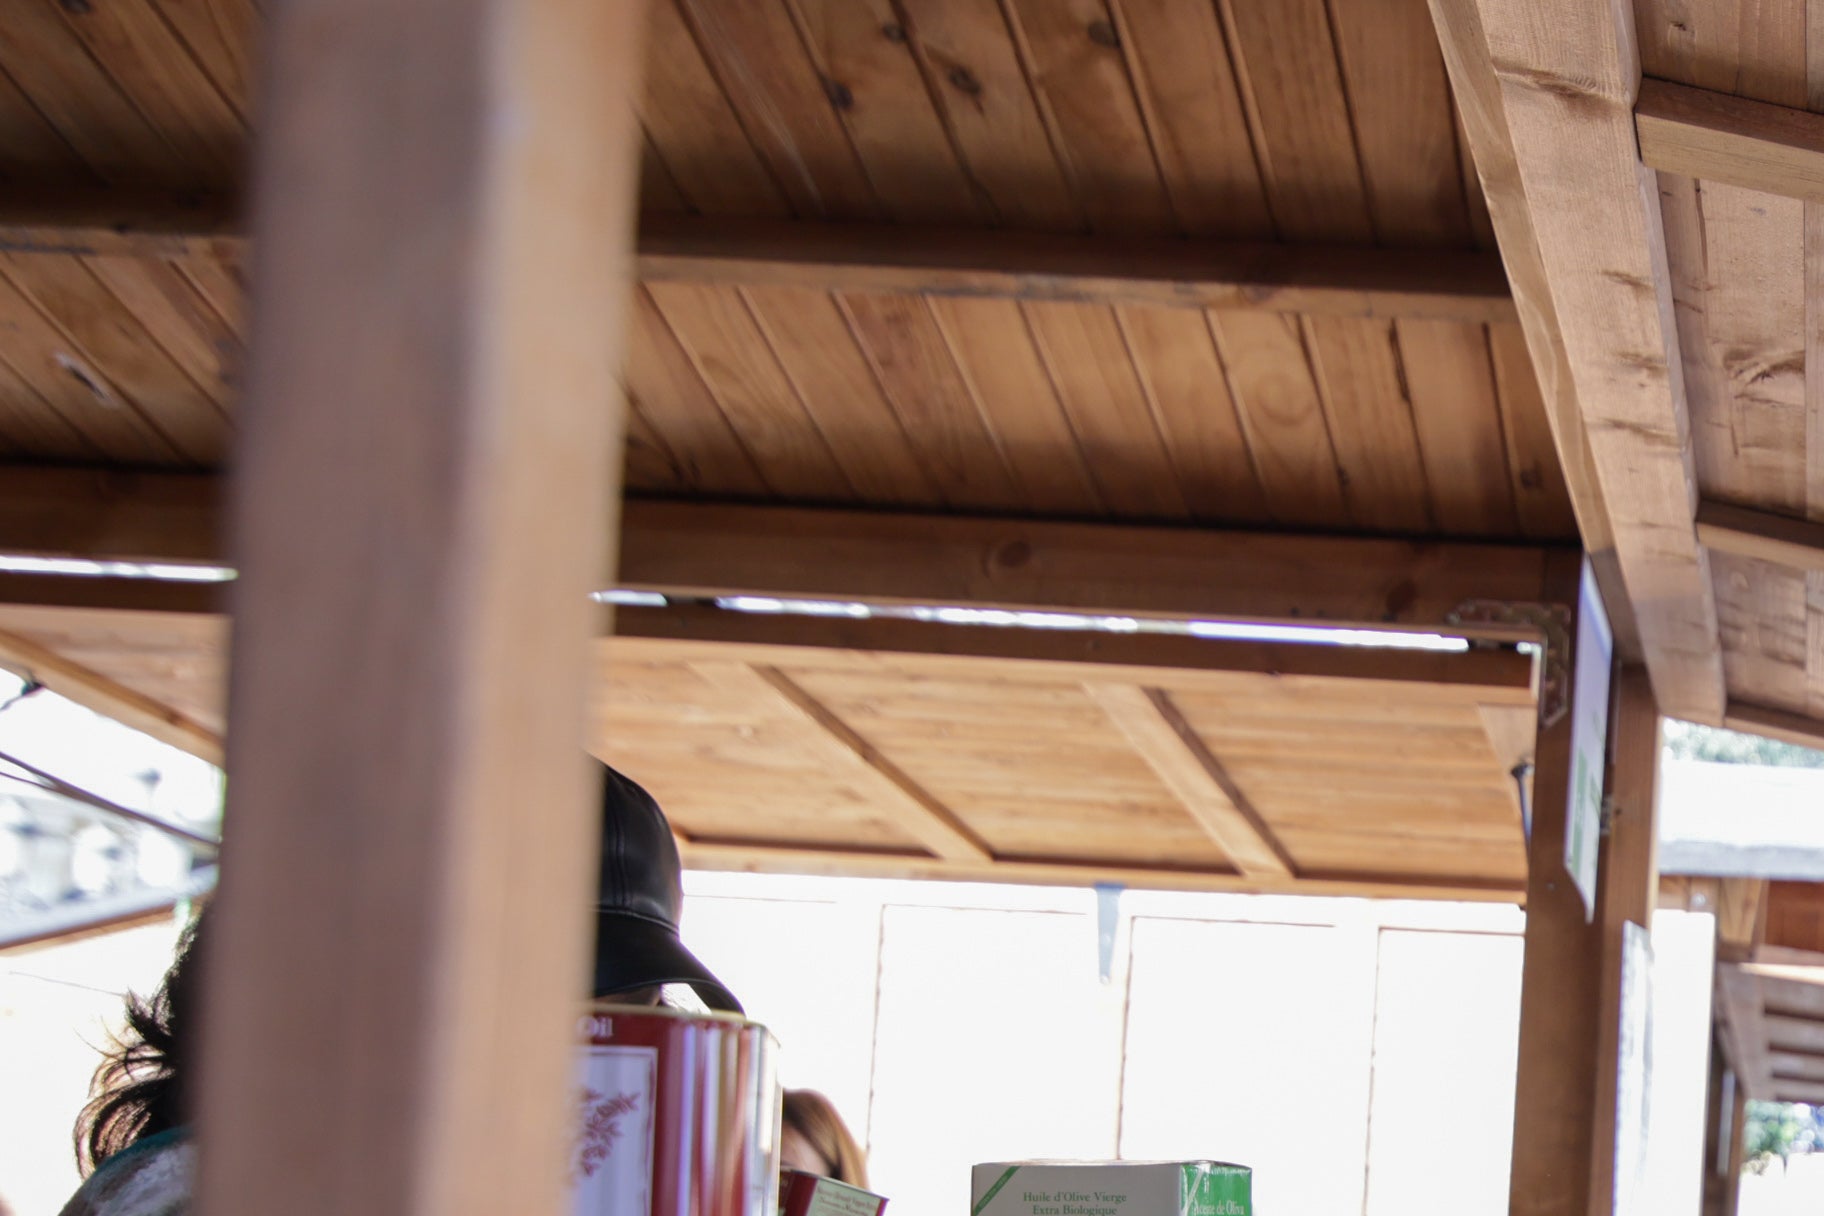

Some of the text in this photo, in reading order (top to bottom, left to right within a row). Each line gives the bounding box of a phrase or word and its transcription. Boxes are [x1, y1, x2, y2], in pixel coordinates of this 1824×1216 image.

[1023, 1191, 1127, 1205] Huile d'Olive Vierge
[1032, 1206, 1060, 1216] Extra
